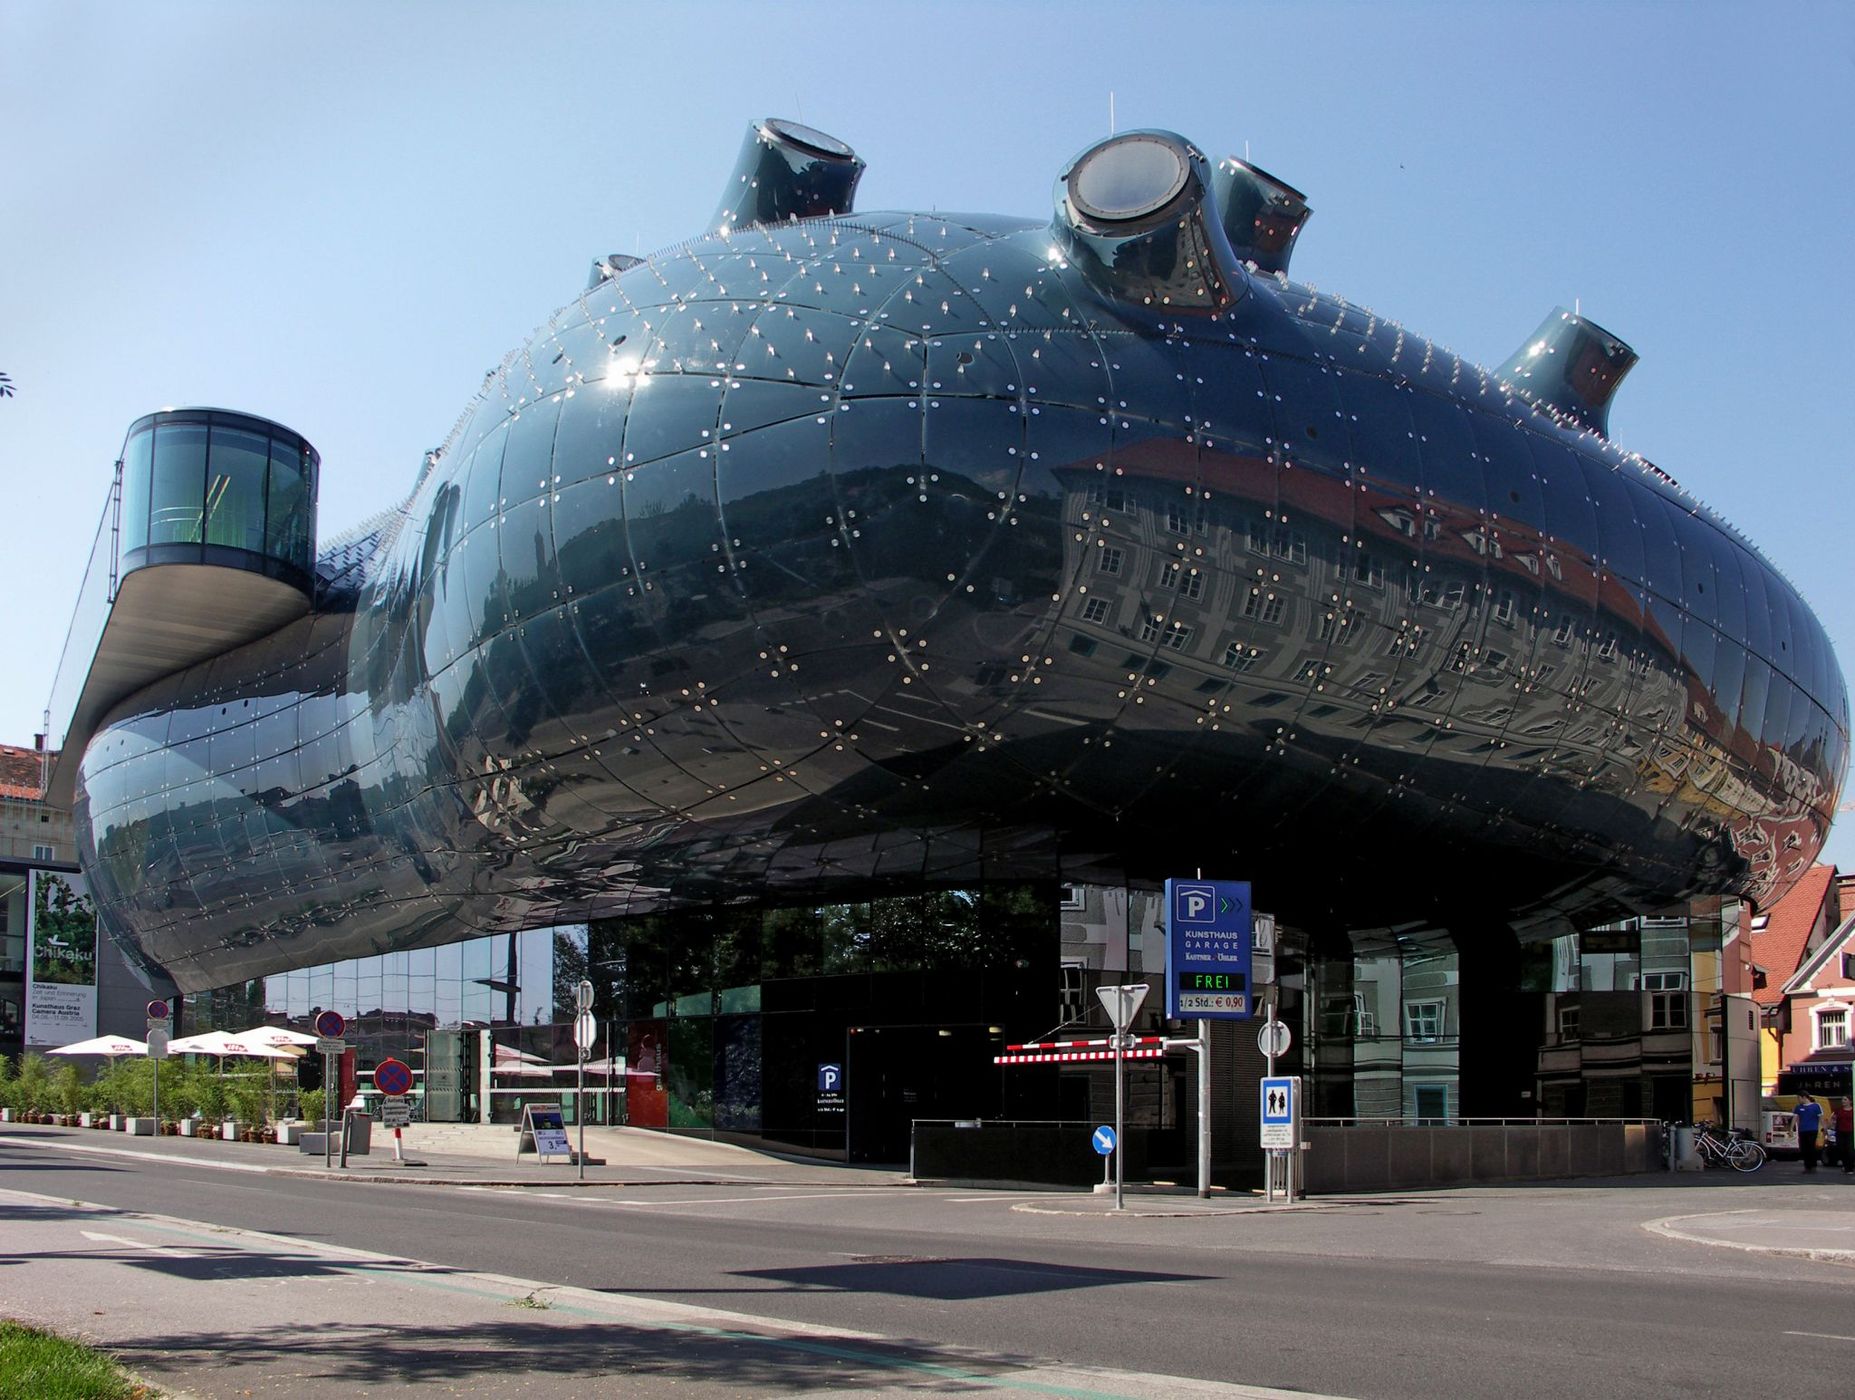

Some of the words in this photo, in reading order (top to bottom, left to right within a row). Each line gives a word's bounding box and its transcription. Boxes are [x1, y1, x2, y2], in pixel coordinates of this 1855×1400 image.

[1188, 897, 1205, 917] P
[1185, 930, 1238, 939] KUNSTHAUS
[1185, 941, 1238, 949] GARAGE
[1195, 975, 1229, 989] FREI
[1180, 997, 1193, 1008] 1/2
[1195, 996, 1214, 1008] Std.:
[1215, 996, 1223, 1007] €
[1225, 996, 1243, 1008] 0,90
[825, 1071, 837, 1089] P
